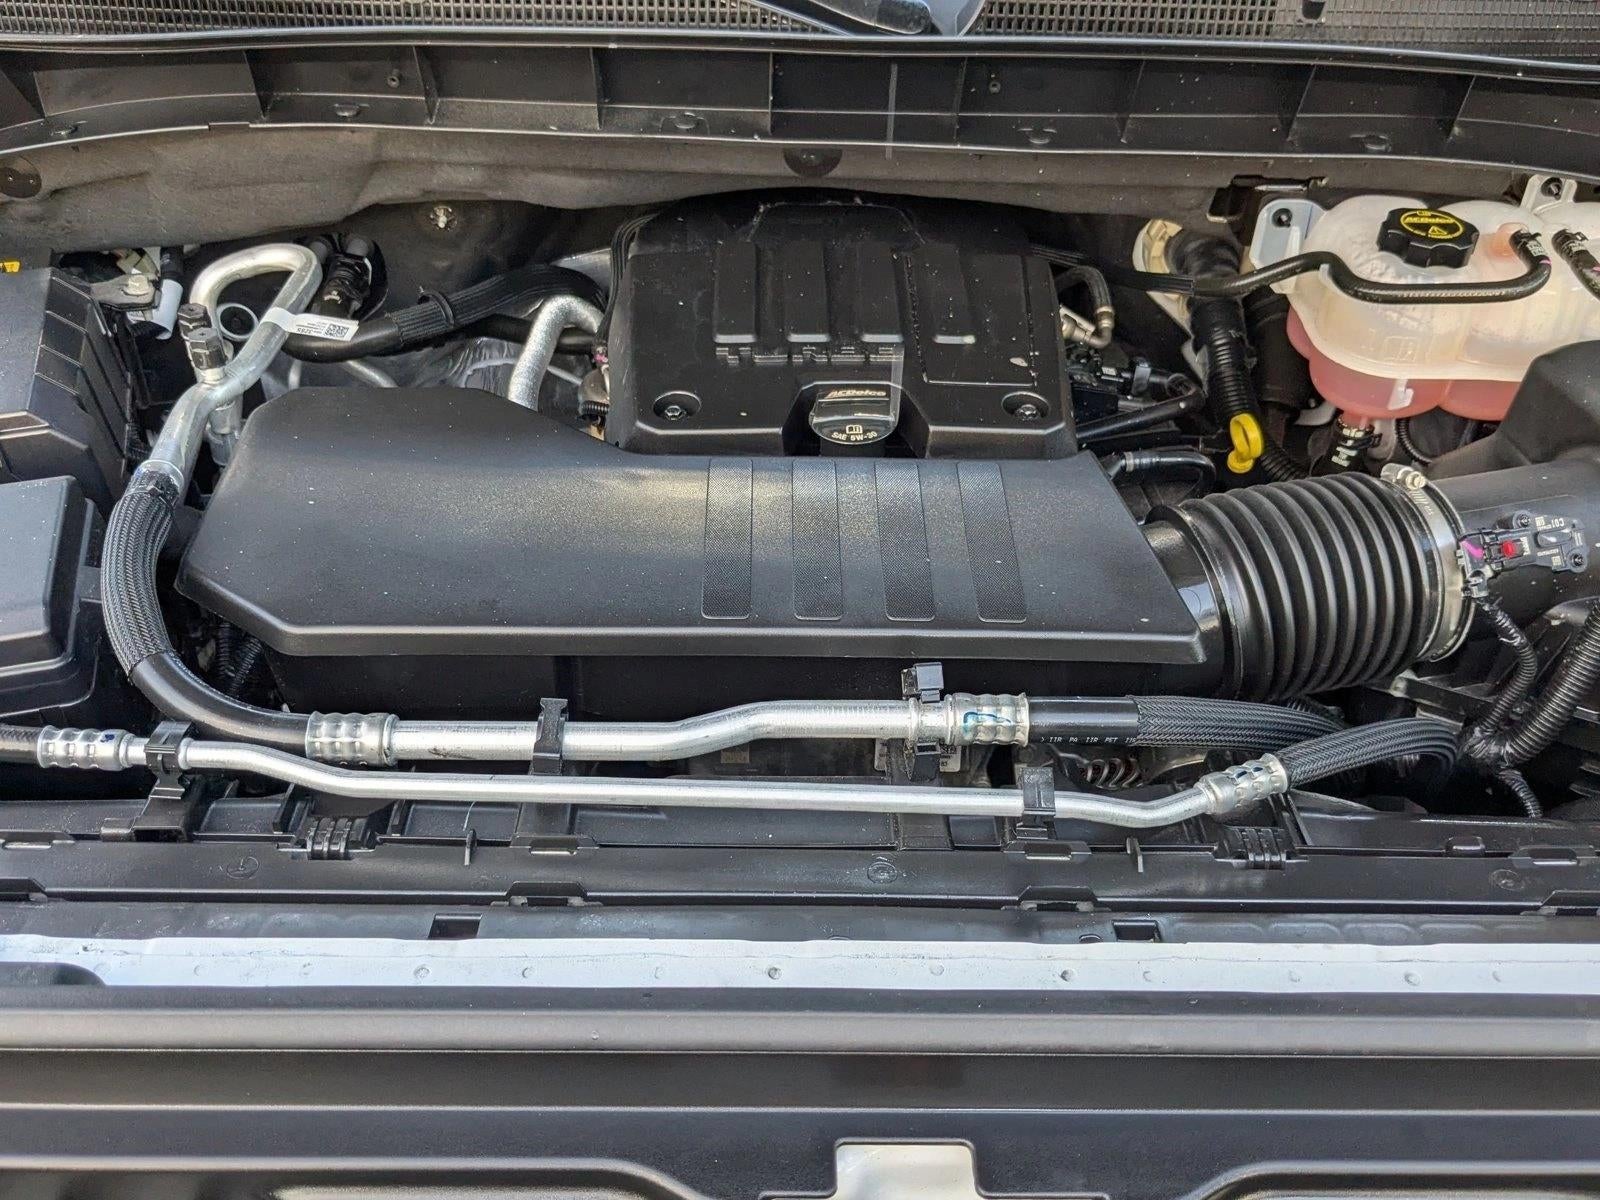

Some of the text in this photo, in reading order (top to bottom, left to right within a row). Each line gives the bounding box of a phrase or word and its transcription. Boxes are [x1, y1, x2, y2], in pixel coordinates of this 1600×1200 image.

[824, 389, 887, 398] ACDelco
[831, 431, 878, 441] SAE 5W-30
